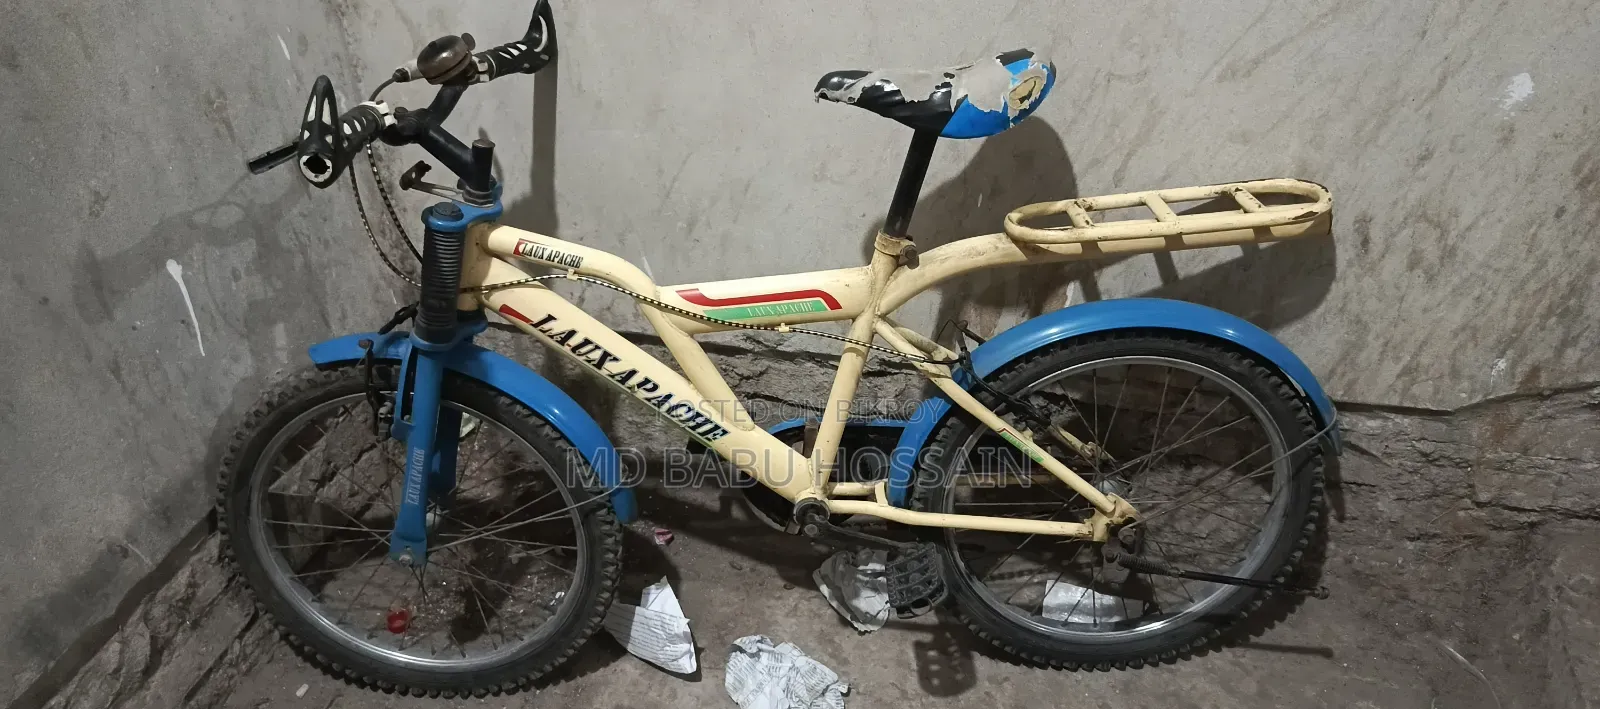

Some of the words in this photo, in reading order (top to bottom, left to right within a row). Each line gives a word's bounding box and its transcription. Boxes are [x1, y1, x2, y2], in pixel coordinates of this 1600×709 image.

[522, 243, 547, 260] LAUX
[545, 249, 583, 268] APACHE
[747, 304, 775, 317] LAUX
[776, 301, 815, 314] APACHE
[529, 313, 620, 370] LAUX
[609, 368, 731, 442] APACHE
